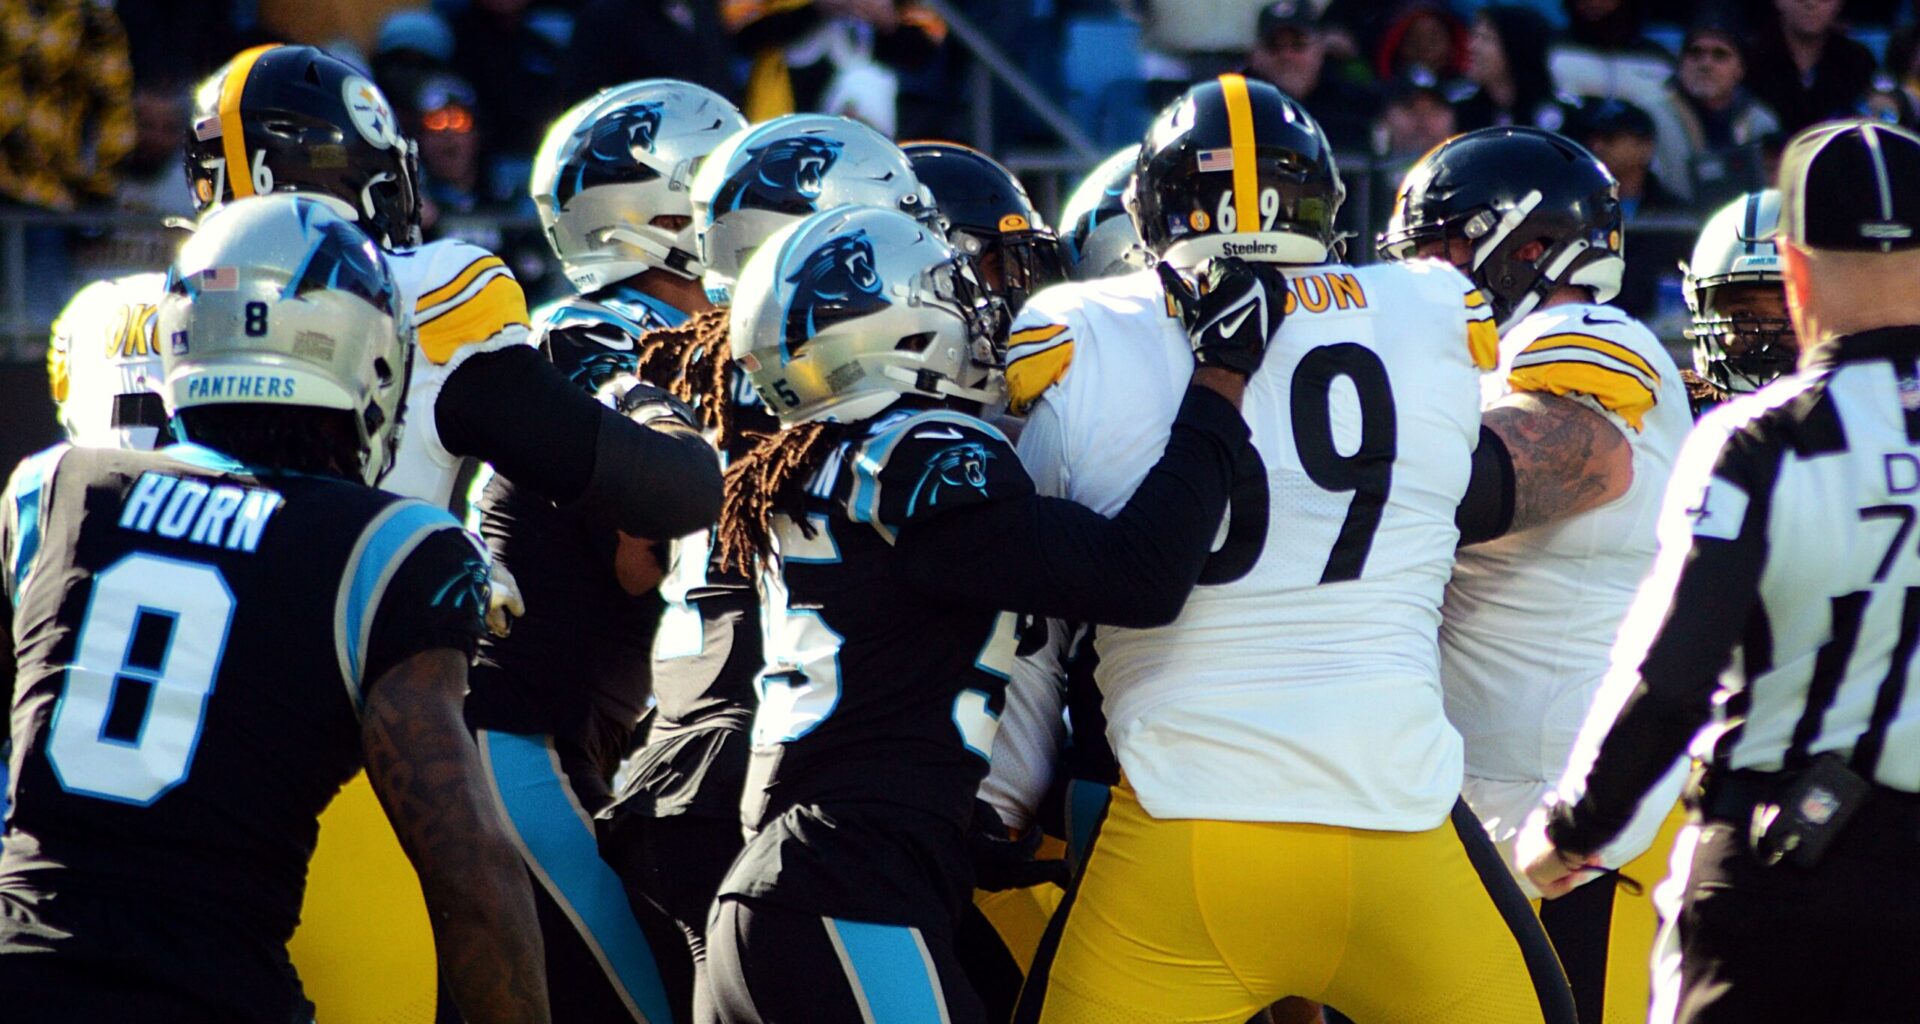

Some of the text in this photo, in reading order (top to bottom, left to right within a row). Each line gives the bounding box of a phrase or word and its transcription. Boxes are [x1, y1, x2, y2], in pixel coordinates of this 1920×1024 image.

[1217, 189, 1280, 234] 69
[1222, 239, 1278, 256] Steelers
[245, 301, 269, 337] 8
[188, 376, 295, 398] PANTHERS
[118, 470, 283, 553] HORN
[1858, 504, 1920, 584] 7
[45, 550, 237, 808] 8
